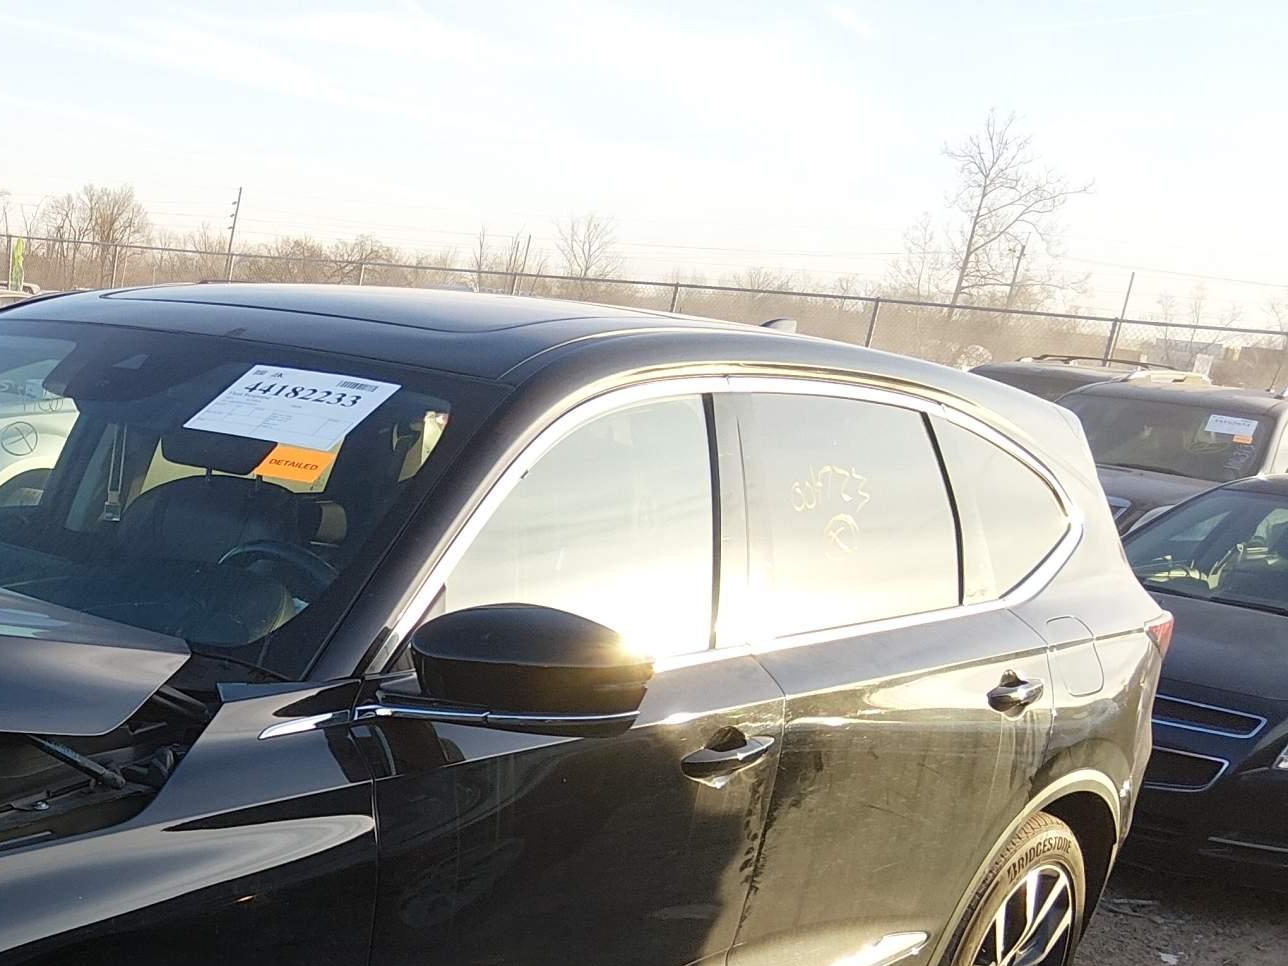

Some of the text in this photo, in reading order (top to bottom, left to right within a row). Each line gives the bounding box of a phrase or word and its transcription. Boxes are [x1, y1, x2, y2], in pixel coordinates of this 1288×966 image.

[244, 381, 363, 408] 44182233
[268, 458, 319, 471] DETAILED
[1006, 835, 1073, 884] BRIDGESTONE
